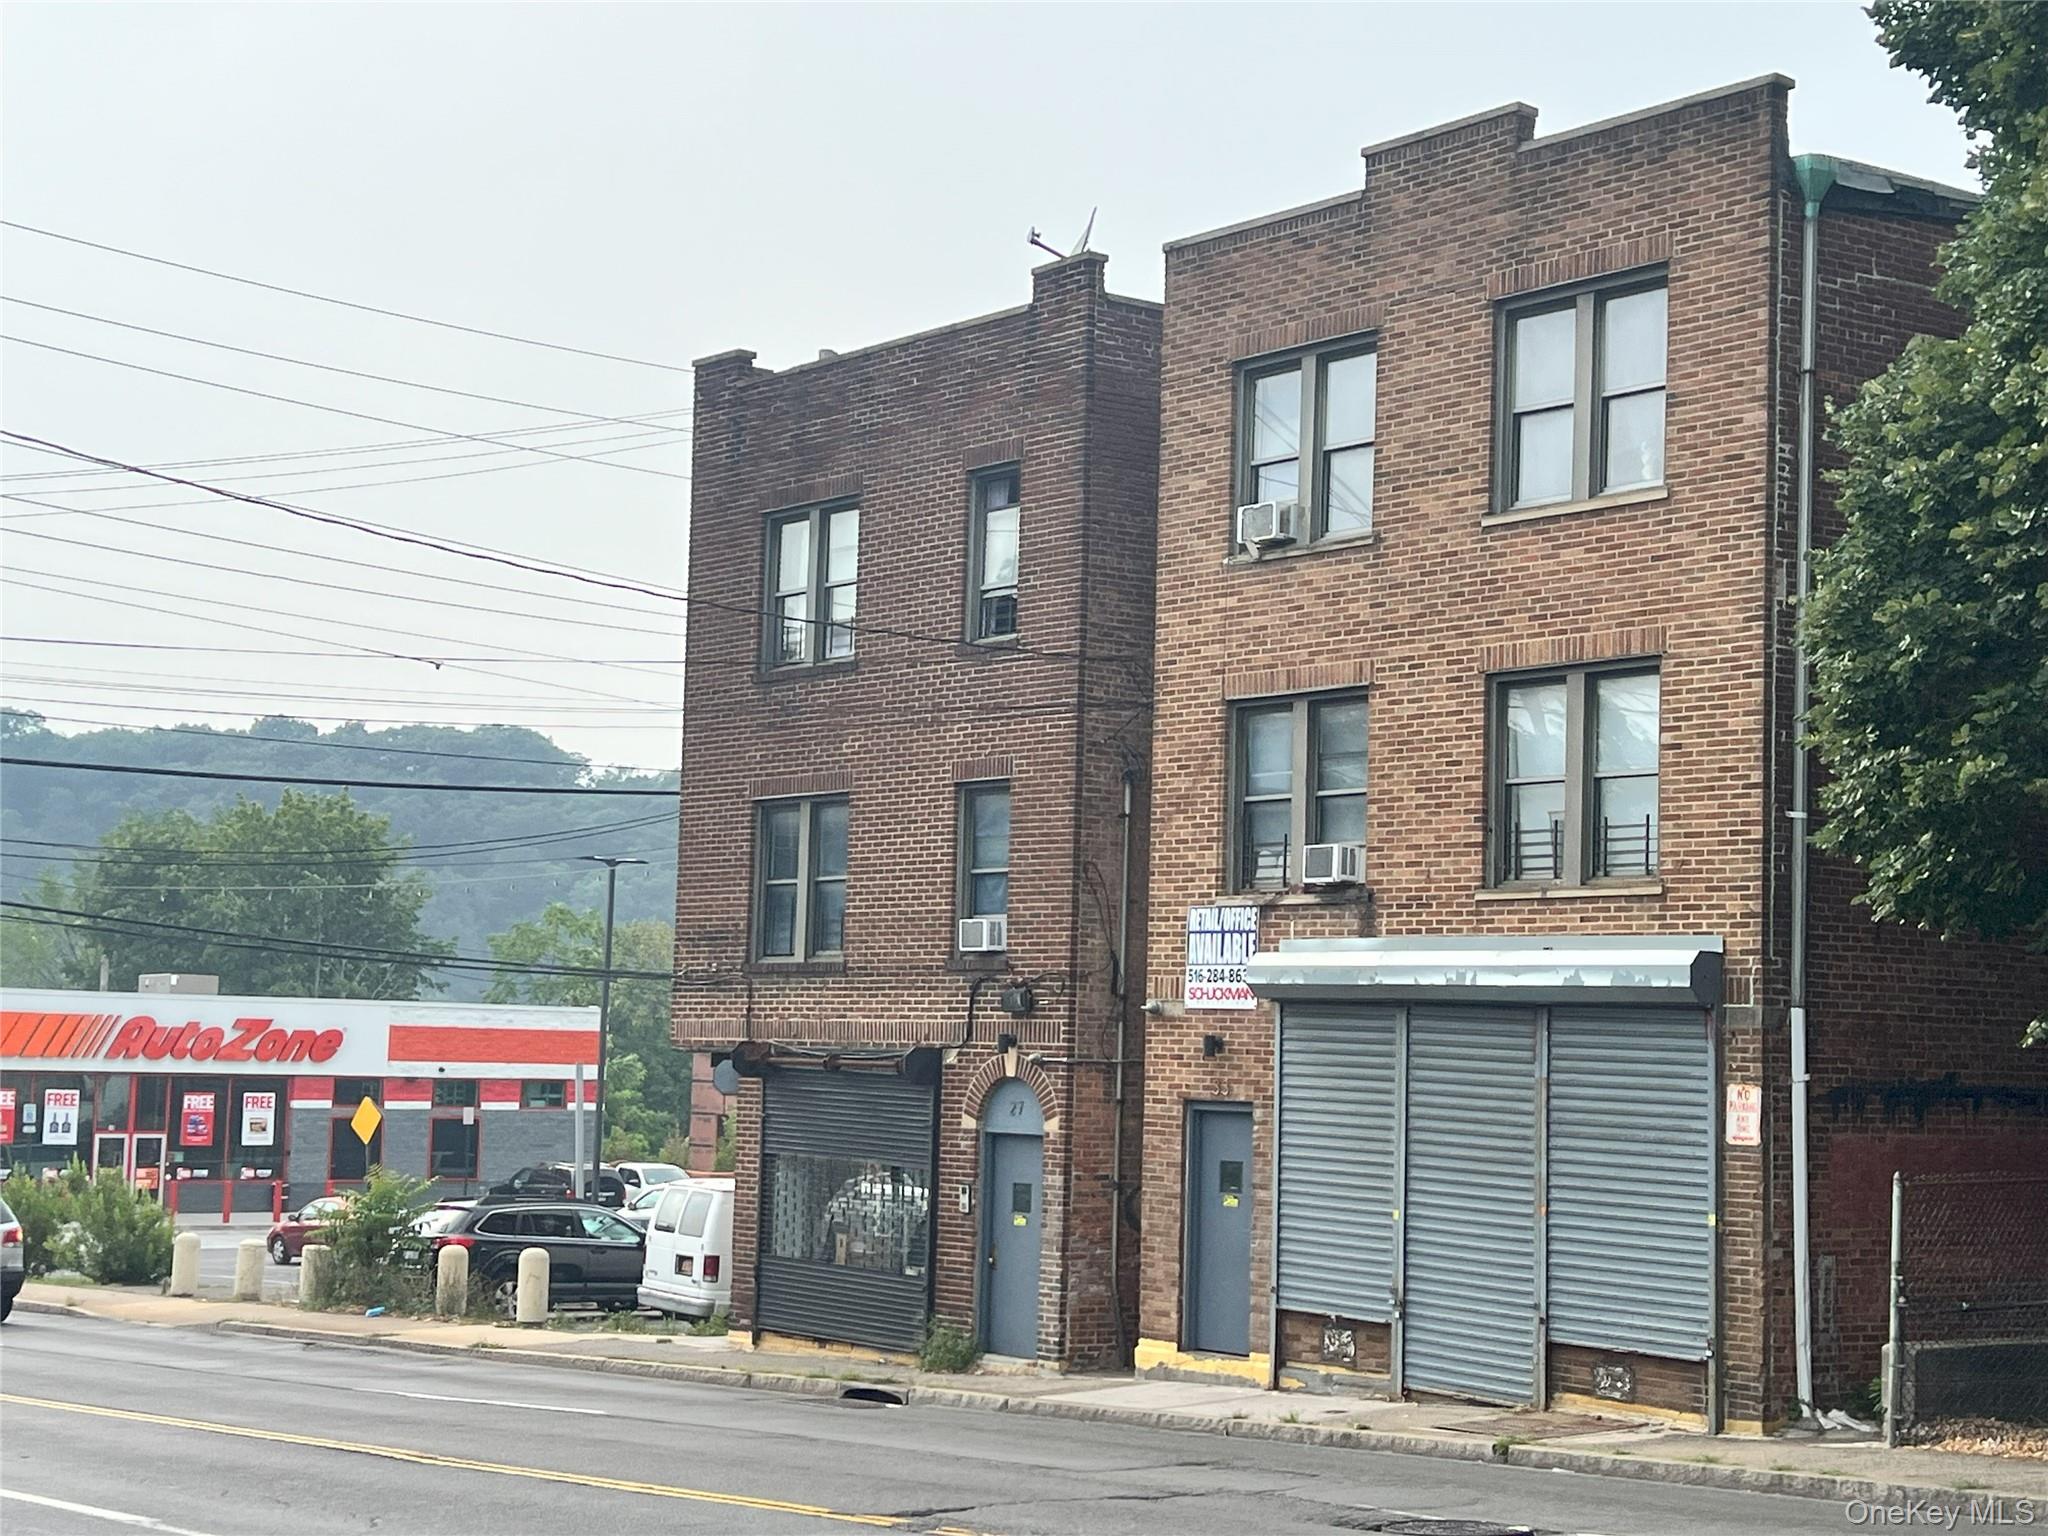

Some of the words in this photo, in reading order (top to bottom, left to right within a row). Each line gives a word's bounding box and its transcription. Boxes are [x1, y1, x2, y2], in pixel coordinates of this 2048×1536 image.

[1189, 906, 1258, 931] RETAIL/OFFICE
[1188, 932, 1257, 964] AVAILABLE
[104, 1015, 345, 1064] AutoZone
[46, 1092, 78, 1107] FREE
[184, 1094, 215, 1110] FREE
[245, 1095, 273, 1109] FREE
[1737, 1089, 1751, 1101] NO
[1010, 1101, 1025, 1117] 27
